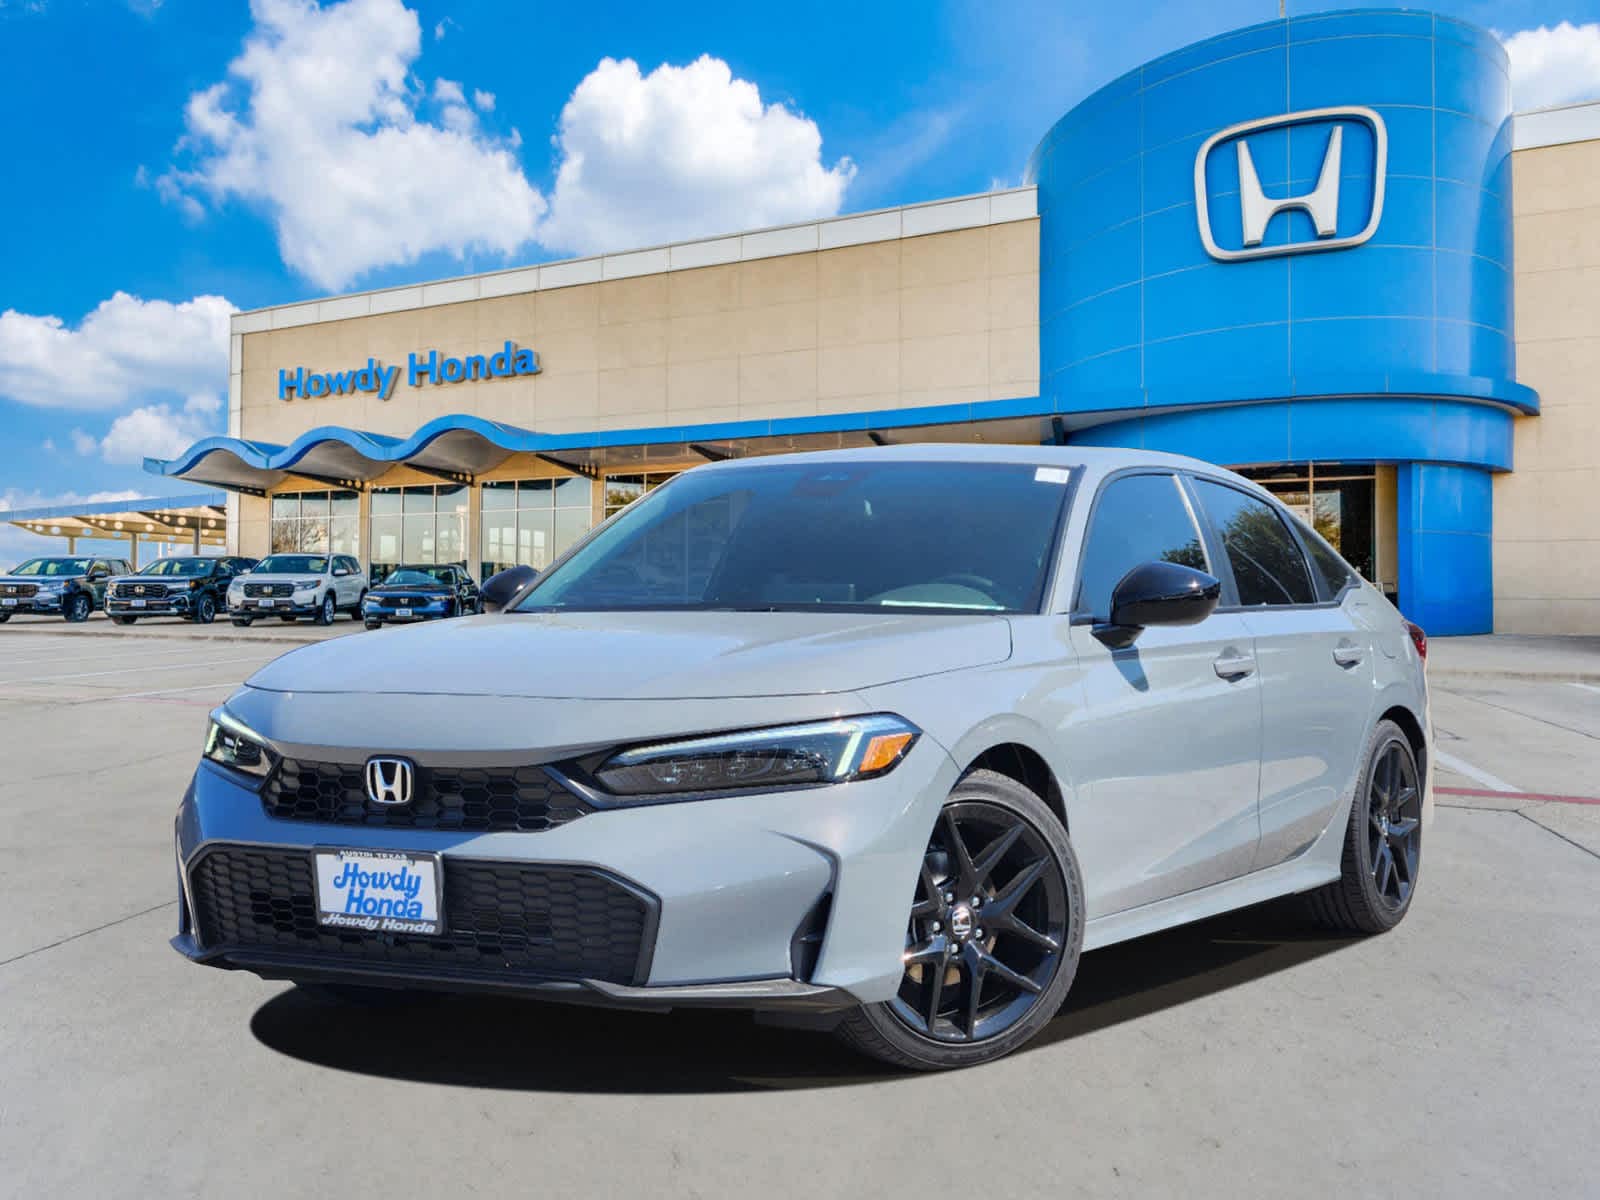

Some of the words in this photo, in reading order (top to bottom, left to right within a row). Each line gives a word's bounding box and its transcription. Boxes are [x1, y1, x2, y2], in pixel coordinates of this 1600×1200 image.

[279, 358, 400, 400] Howdy
[408, 340, 541, 386] Honda
[340, 849, 373, 858] AUSTIN
[376, 852, 407, 861] TEXAS
[333, 862, 422, 899] Howdy
[345, 888, 423, 920] Honda
[322, 914, 379, 930] Howdy
[381, 918, 436, 933] Honda
